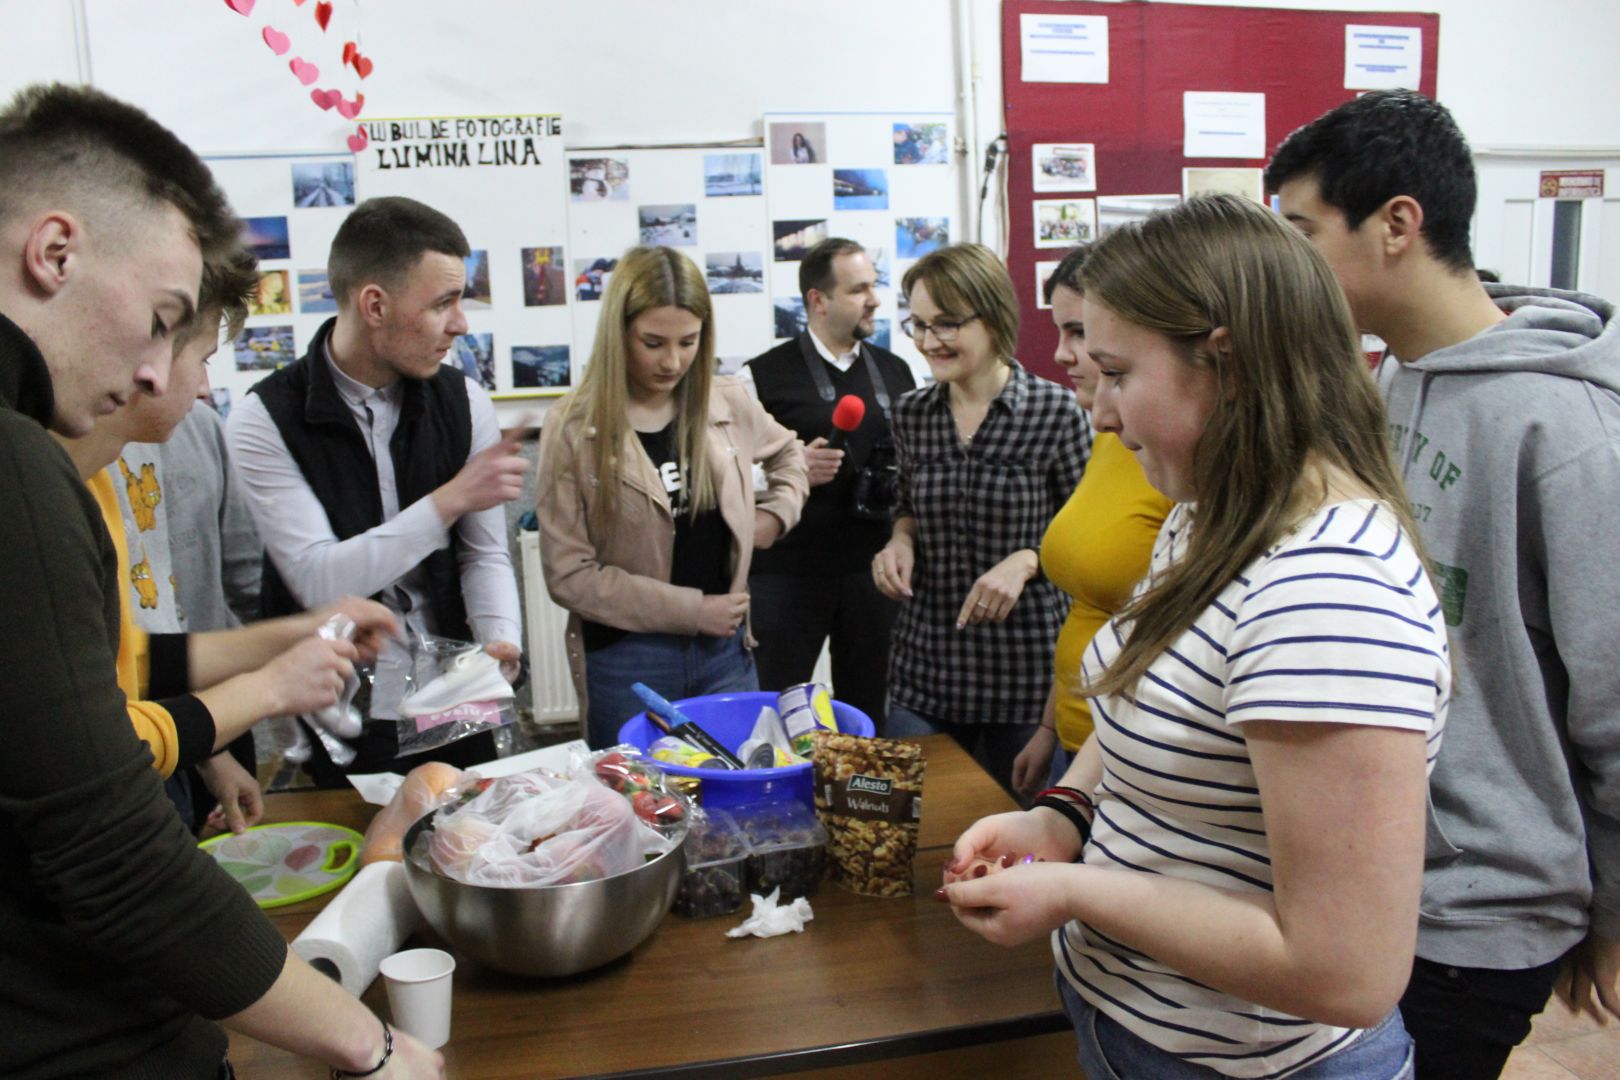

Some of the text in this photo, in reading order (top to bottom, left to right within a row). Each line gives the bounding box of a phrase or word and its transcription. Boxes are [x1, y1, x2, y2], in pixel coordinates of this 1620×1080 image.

[431, 119, 451, 139] DE
[456, 116, 561, 139] FOTOGRAFIE
[1430, 450, 1461, 490] OF
[851, 777, 888, 791] Alesto
[847, 797, 889, 813] Walnuts
